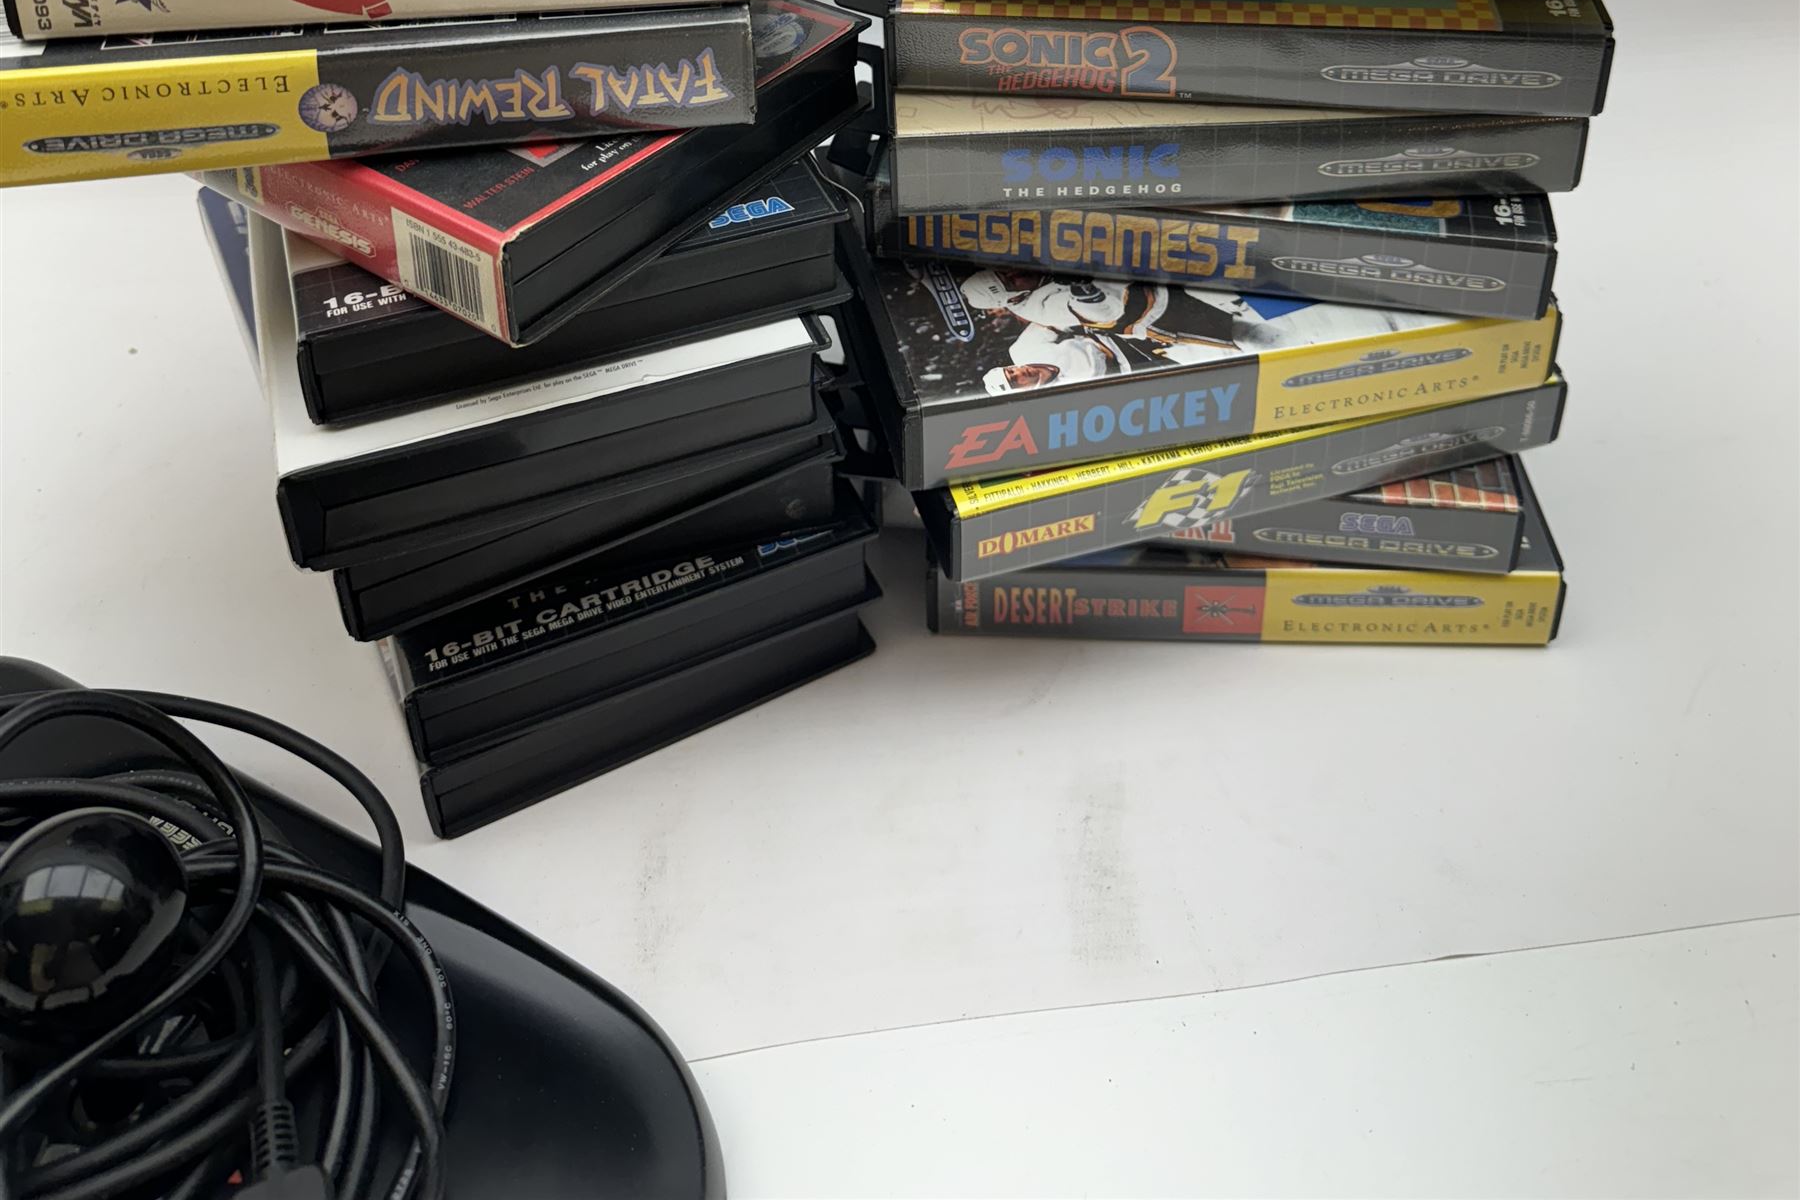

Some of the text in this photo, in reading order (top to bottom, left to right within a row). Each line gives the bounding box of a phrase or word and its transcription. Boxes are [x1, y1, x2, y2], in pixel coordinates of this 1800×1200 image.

[959, 26, 1178, 97] SONIC 2
[989, 65, 1008, 75] THE
[1341, 68, 1541, 86] MEGA DRIVE
[103, 74, 290, 103] ELECTRONIC
[360, 62, 575, 128] REWIND
[570, 46, 736, 115] FATAL
[998, 66, 1118, 92] HEDGEHOG
[44, 125, 259, 152] MEGA DRIVE
[580, 161, 599, 171] for
[599, 149, 619, 165] play
[1001, 143, 1181, 183] SONIC
[1338, 155, 1521, 175] MEGA DRIVE
[462, 166, 535, 210] WALTER STEIN
[1003, 183, 1183, 199] THE HEDGEHOG
[709, 196, 795, 230] SEGA
[290, 205, 373, 255] GENESIS
[406, 218, 425, 235] ISBN
[433, 231, 446, 246] 555
[908, 209, 1260, 280] MEGA GAMES I
[1290, 259, 1486, 289] MEGA DRIVE
[326, 293, 407, 318] FOR USE WITH
[1299, 349, 1462, 386] MEGA DRIVE
[1274, 386, 1408, 419] ELECTRONIC
[944, 383, 1240, 470] EA HOCKEY
[983, 486, 1024, 503] FITTIPALDI
[1030, 475, 1069, 494] HAKKINEN
[1076, 465, 1110, 482] HERBERT
[1117, 460, 1134, 472] HILL
[1141, 449, 1181, 468] KATAYAMA
[1134, 469, 1253, 529] F1
[980, 517, 1090, 557] DOMARK
[1340, 513, 1415, 536] SEGA
[1277, 531, 1476, 557] MEGA DRIVE
[425, 621, 522, 663] 16-BIT
[535, 555, 716, 626] CARTRIDGE
[429, 555, 745, 672] FOR USE WITH THE SEGA MEGA DRIVE VIDEO ENTERTAINMENT SYSTEM
[993, 587, 1178, 624] DESERT STRIKE
[1309, 595, 1470, 607] MEGA DRIVE
[1284, 619, 1417, 633] ELECTRONIC
